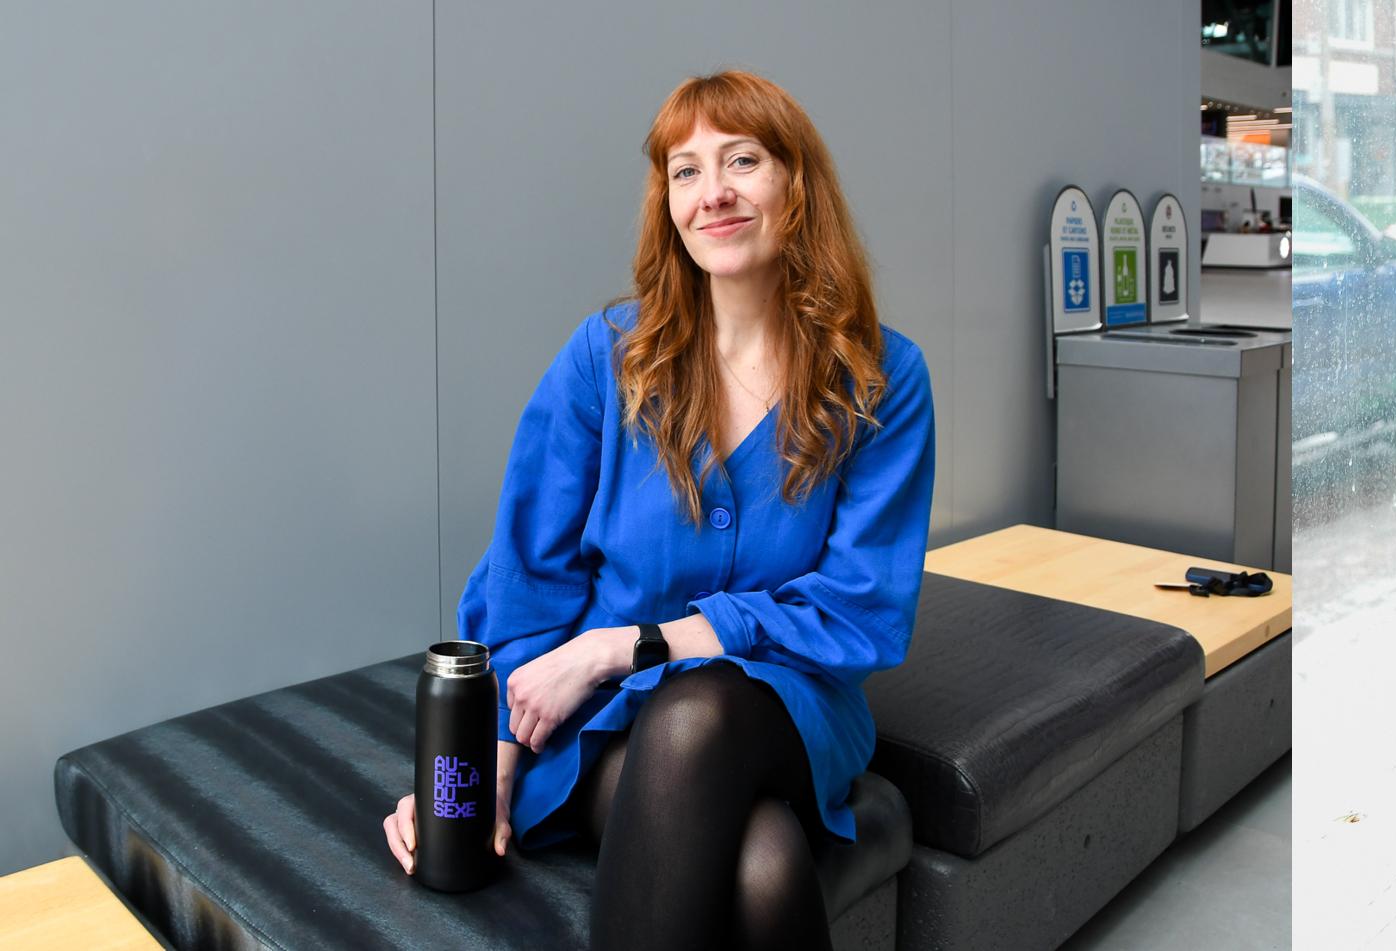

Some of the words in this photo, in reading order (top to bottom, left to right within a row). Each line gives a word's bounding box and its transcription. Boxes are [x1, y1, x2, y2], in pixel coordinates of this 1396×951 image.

[434, 755, 469, 772] AU-
[434, 767, 480, 788] DELÀ
[434, 786, 456, 802] DU
[433, 801, 477, 818] SEXE
